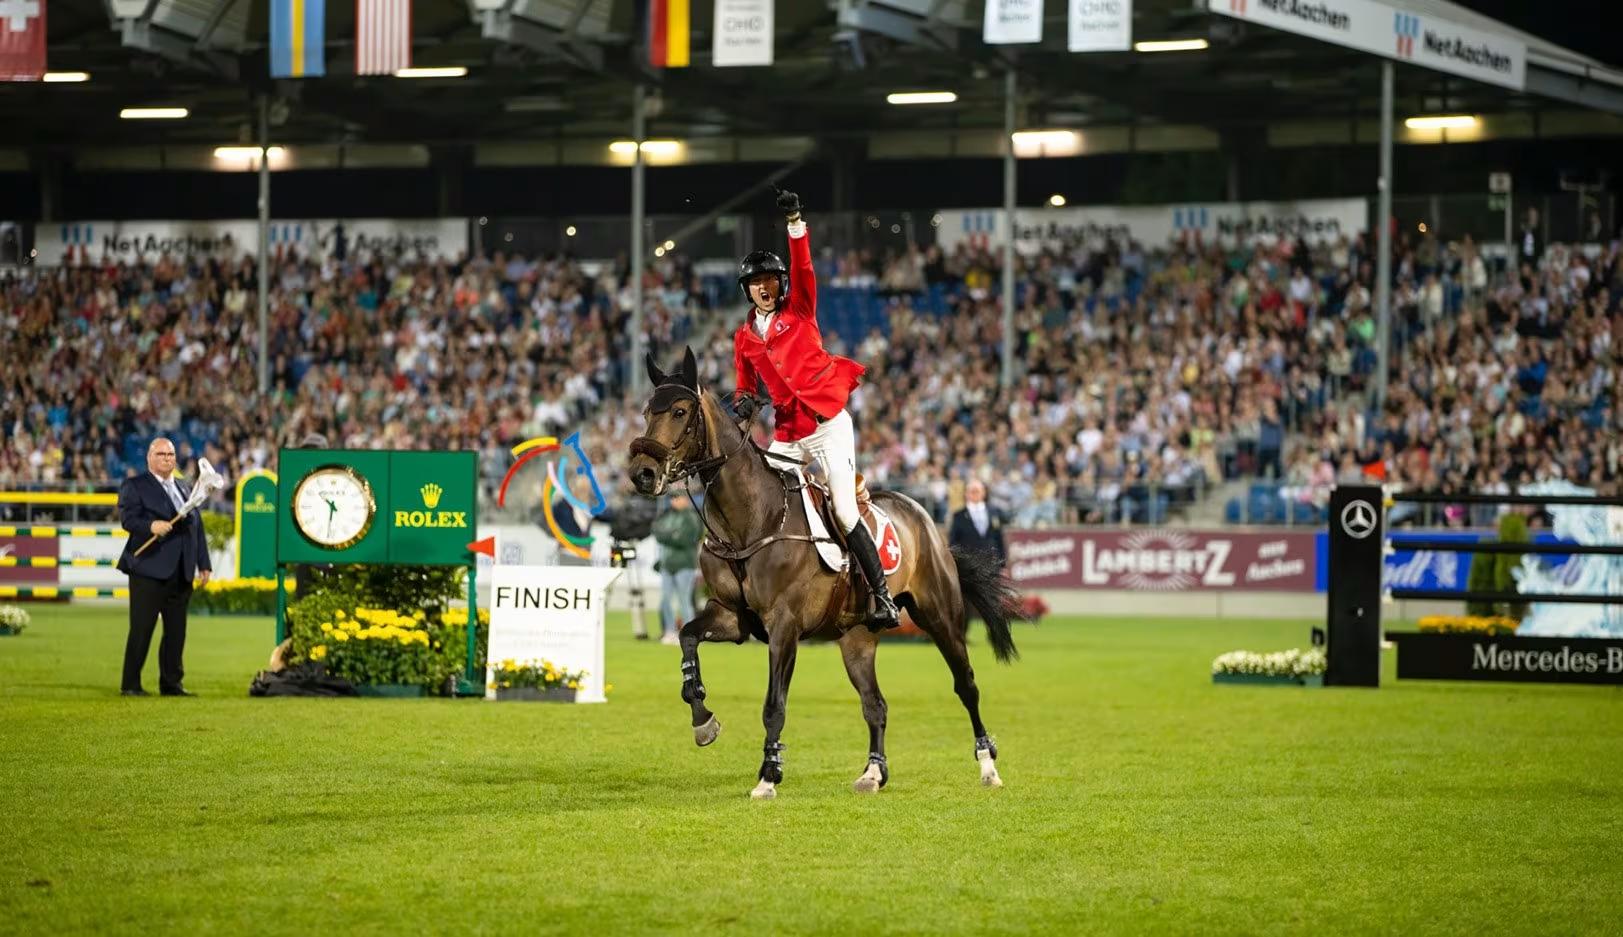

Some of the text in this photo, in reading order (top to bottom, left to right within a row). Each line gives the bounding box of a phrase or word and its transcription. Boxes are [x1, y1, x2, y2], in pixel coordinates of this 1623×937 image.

[1423, 29, 1512, 74] NetAachen
[394, 511, 468, 528] ROLEX
[1082, 539, 1236, 586] LAMBERTZ
[496, 586, 591, 610] FINISH
[1471, 642, 1623, 674] Mercedes-B
